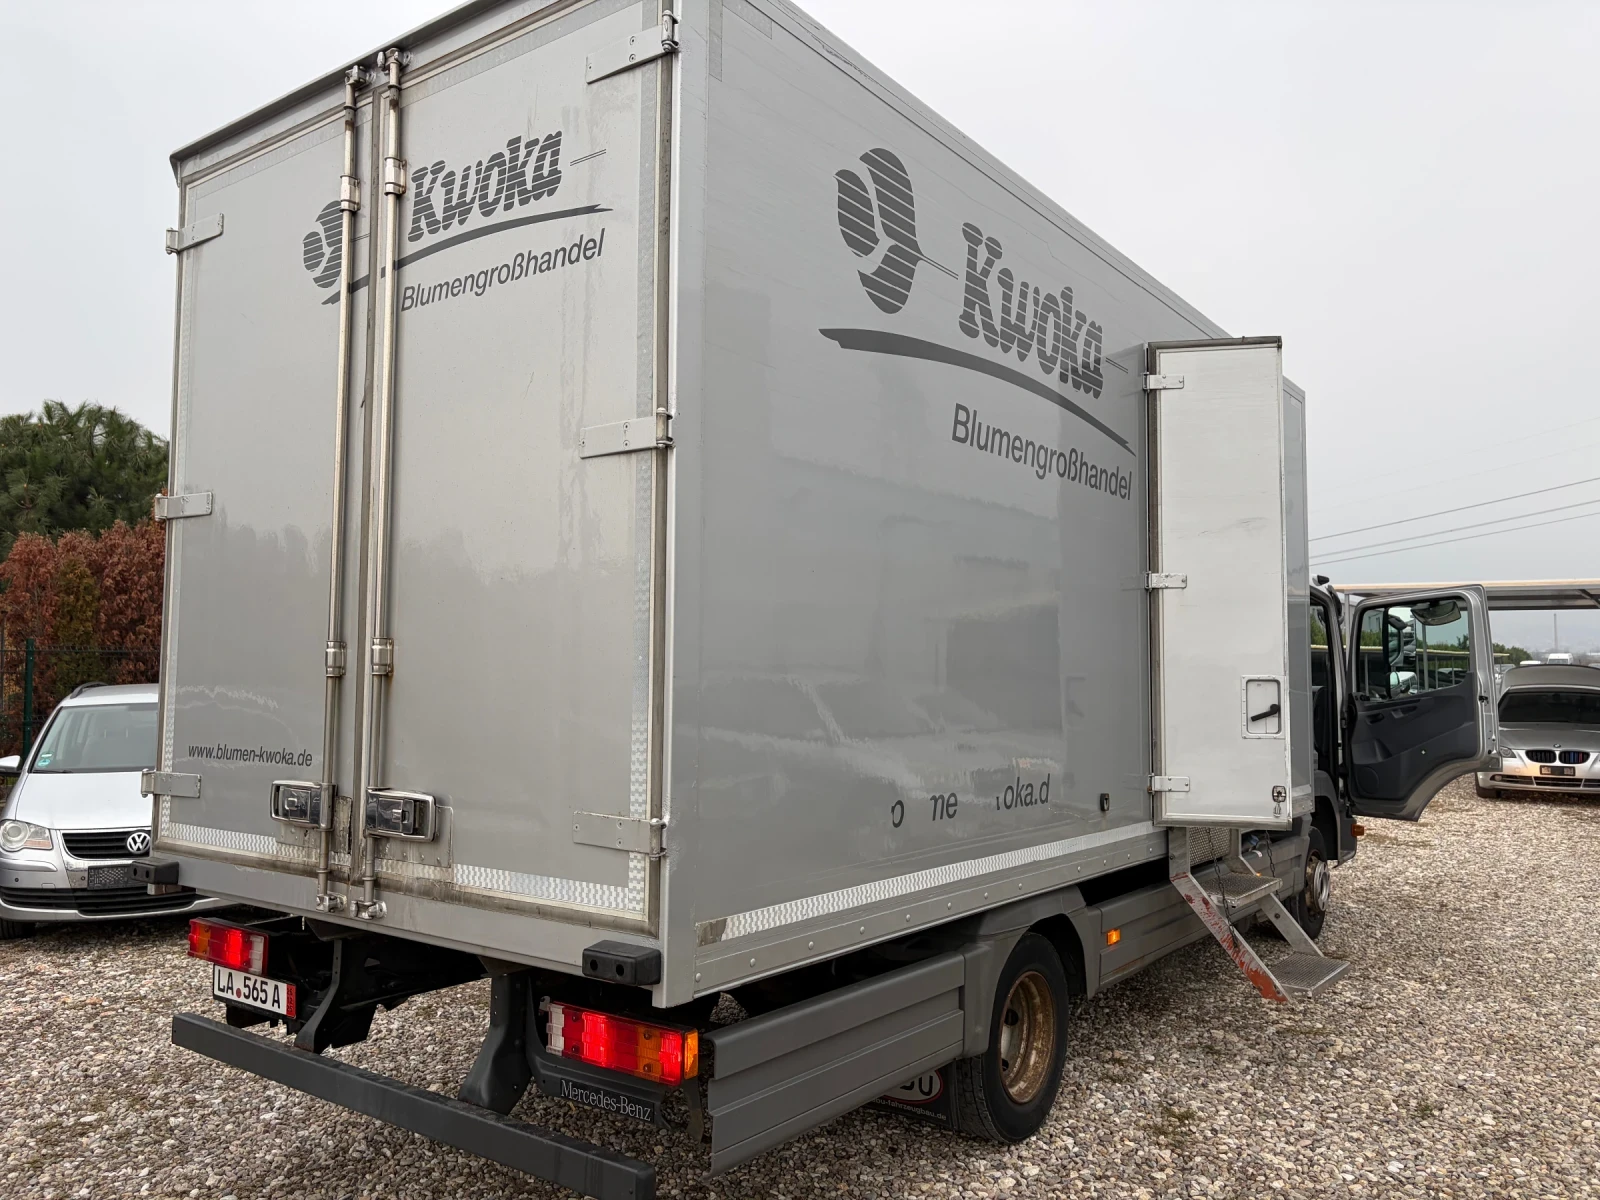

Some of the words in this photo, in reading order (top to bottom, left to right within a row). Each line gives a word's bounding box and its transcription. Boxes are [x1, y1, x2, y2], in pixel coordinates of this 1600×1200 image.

[408, 130, 563, 243] Kwoka
[400, 227, 606, 312] Blumengroßhandel
[958, 222, 1104, 400] Kwoka
[951, 403, 1133, 501] Blumengroßhandel
[188, 743, 313, 767] www.blumen-kwoka.de
[217, 969, 234, 996] LA
[243, 975, 269, 1005] 565
[271, 983, 281, 1010] A
[560, 1079, 651, 1122] Mercedes-Benz
